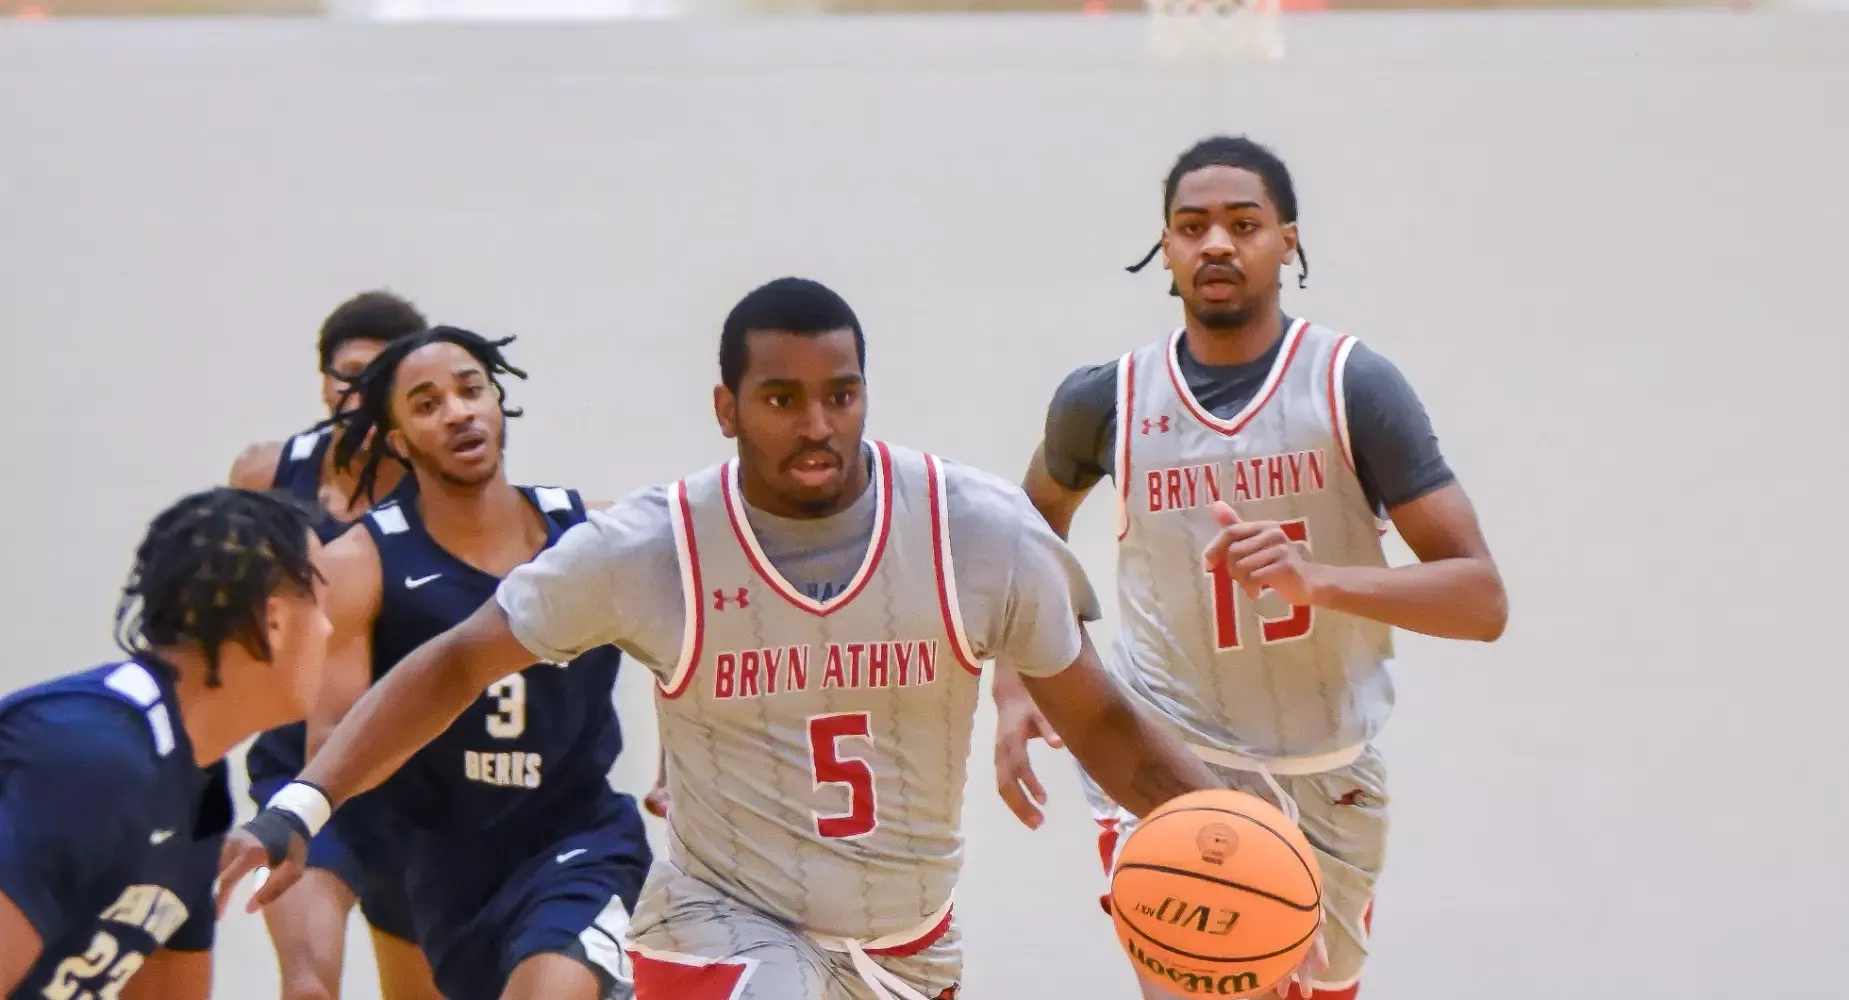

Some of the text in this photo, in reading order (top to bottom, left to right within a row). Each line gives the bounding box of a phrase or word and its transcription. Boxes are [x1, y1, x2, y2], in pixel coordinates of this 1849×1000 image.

[1147, 448, 1324, 513] BRYN ATHYN
[1204, 516, 1314, 653] 15
[713, 639, 938, 699] BRYN ATHYN
[485, 671, 526, 739] 3
[464, 749, 542, 789] BERKS
[807, 711, 877, 839] 5
[1155, 896, 1241, 936] EVO
[1128, 938, 1260, 996] Wilson
